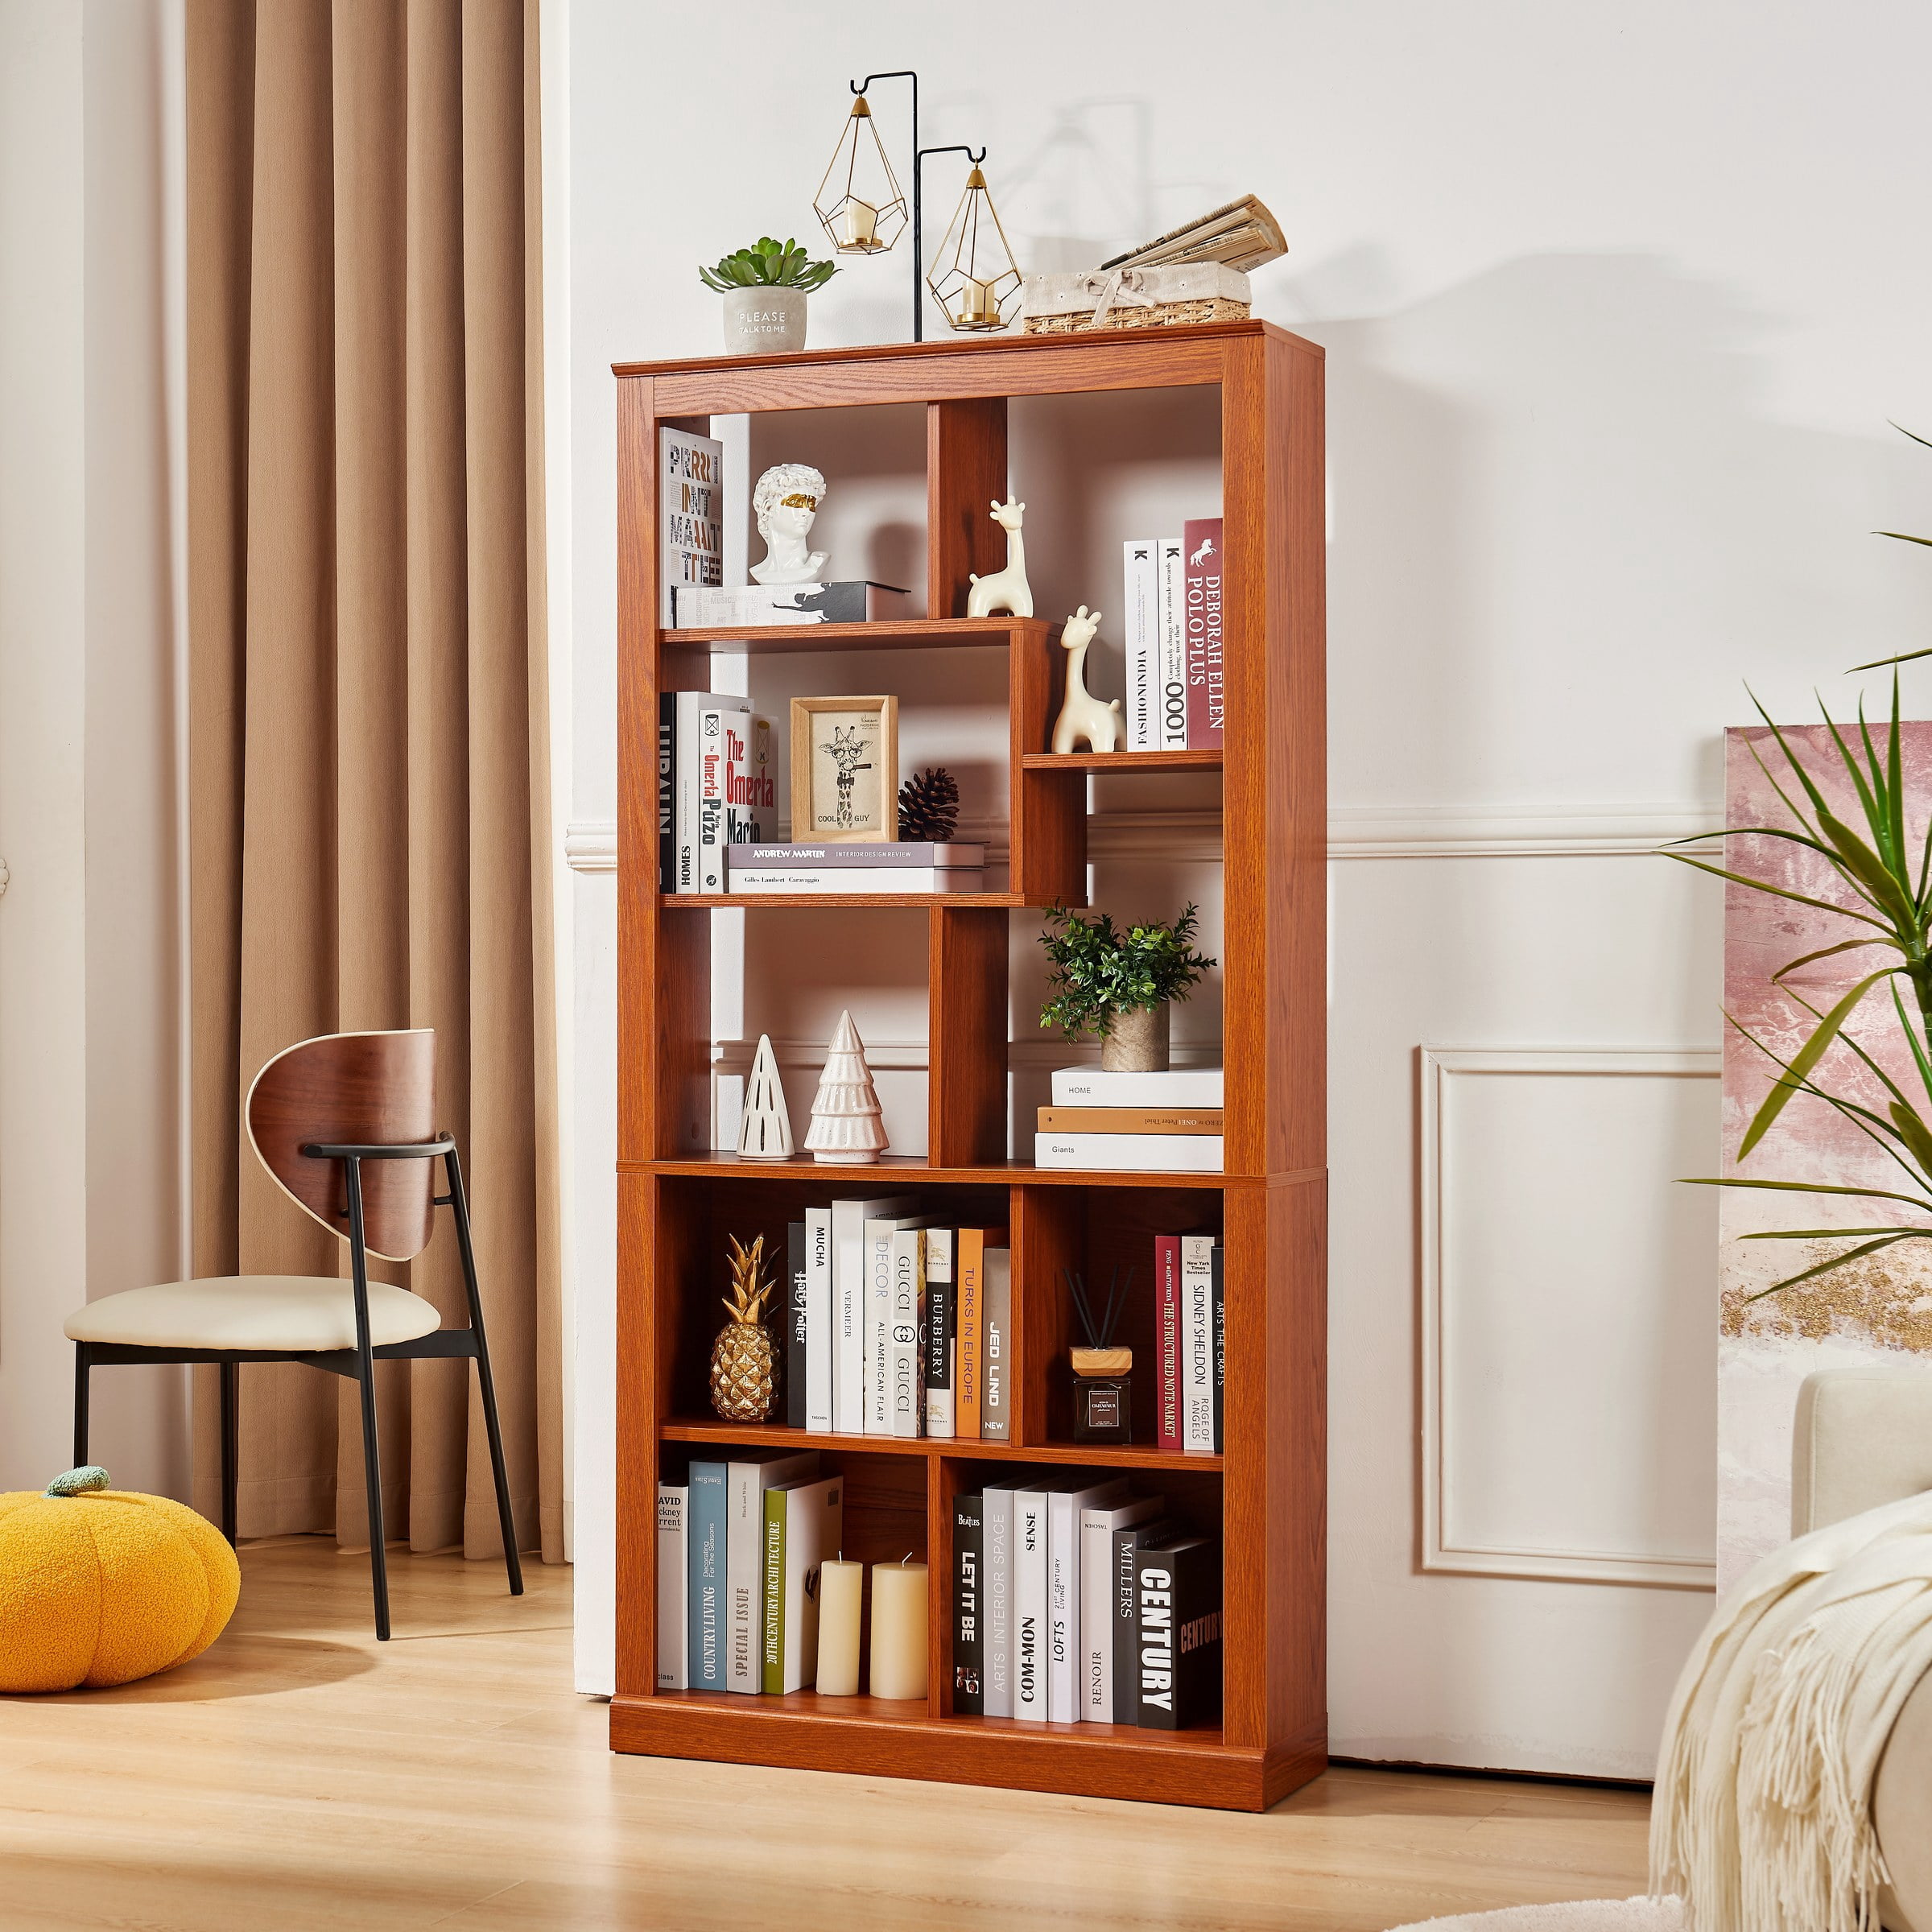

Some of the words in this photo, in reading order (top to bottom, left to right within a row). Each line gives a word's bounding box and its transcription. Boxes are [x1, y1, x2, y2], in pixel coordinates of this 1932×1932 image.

[739, 312, 786, 323] PLEASE
[739, 325, 759, 334] TALK
[1134, 550, 1148, 561] K
[1166, 547, 1180, 559] K
[1187, 576, 1204, 633] POLO
[1205, 575, 1223, 665] DEBORAH
[1166, 625, 1174, 646] change
[1166, 648, 1174, 680] Completely
[1189, 637, 1206, 686] PLUS
[1137, 650, 1147, 745] FASHIONINDIA
[1166, 682, 1185, 743] 1000
[1208, 671, 1224, 729] ELLEN
[726, 729, 745, 762] The
[704, 754, 720, 797] Omerta
[726, 760, 774, 808] Omerta
[702, 799, 721, 845] Puzo
[726, 807, 762, 844] Mario
[681, 845, 691, 886] HOMES
[752, 849, 791, 859] ANDREW
[791, 849, 826, 859] MARTIN
[745, 876, 761, 884] Gilles
[761, 876, 785, 884] Lambert
[788, 876, 819, 885] Caravaggio
[1068, 1087, 1092, 1095] HOME
[1051, 1146, 1075, 1154] Giants
[815, 1227, 825, 1267] MUCHA
[875, 1242, 889, 1298] DECOR
[898, 1256, 910, 1311] GUCCI
[964, 1267, 975, 1318] TURKS
[1163, 1302, 1175, 1320] THE
[1193, 1285, 1205, 1327] SIDNEY
[932, 1293, 943, 1379] BURBERRY
[964, 1323, 973, 1336] IN
[989, 1321, 1000, 1358] JED
[1163, 1320, 1175, 1377] STRUCTURED
[1216, 1329, 1224, 1347] THE
[877, 1321, 886, 1392] ALL-AMERICAN
[963, 1341, 973, 1404] EUROPE
[1194, 1328, 1206, 1385] SHELDON
[898, 1357, 910, 1413] GUCCI
[989, 1365, 1000, 1406] LIND
[1164, 1377, 1175, 1402] NOTE
[985, 1421, 1004, 1430] NEW
[1191, 1399, 1200, 1439] ANGELS
[1201, 1428, 1210, 1442] OF
[658, 1496, 681, 1505] AVID
[658, 1506, 681, 1518] ckney
[958, 1513, 980, 1528] BEATLES
[658, 1517, 682, 1526] rrent
[993, 1513, 1005, 1564] SPACE
[1026, 1512, 1036, 1552] SENSE
[961, 1551, 976, 1588] LET
[1121, 1542, 1133, 1618] MILLERS
[704, 1586, 716, 1626] LIVING
[736, 1587, 749, 1621] ISSUE
[961, 1592, 975, 1612] IT
[993, 1571, 1005, 1644] INTERIOR
[961, 1616, 975, 1642] BE
[1053, 1620, 1065, 1662] LOFTS
[1140, 1568, 1172, 1711] CENTURY
[1180, 1610, 1223, 1654] CENTURY
[704, 1627, 716, 1680] COUNTRY
[735, 1626, 748, 1677] SPECIAL
[1020, 1616, 1036, 1703] COM-MON
[993, 1652, 1005, 1693] ARTS
[1092, 1651, 1102, 1706] RENOIR
